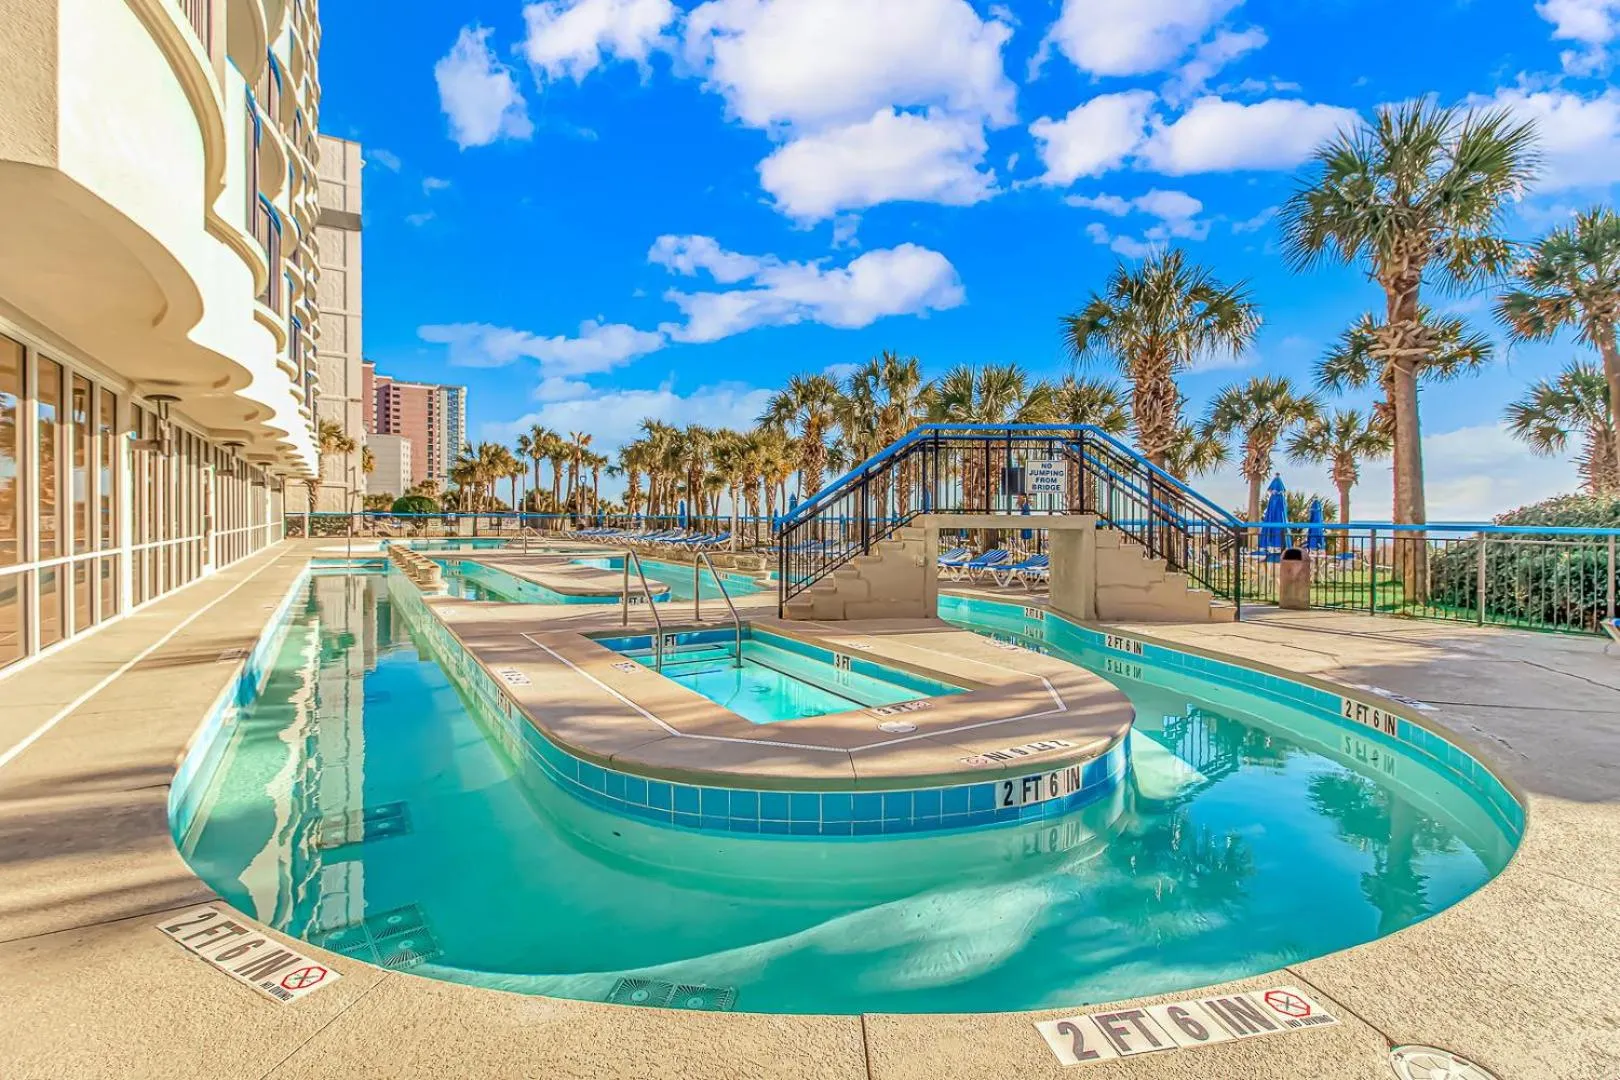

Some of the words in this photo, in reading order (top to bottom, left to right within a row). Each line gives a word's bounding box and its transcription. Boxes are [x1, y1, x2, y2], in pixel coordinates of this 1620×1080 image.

[665, 634, 676, 646] FT
[1108, 635, 1112, 647] 2
[1115, 637, 1123, 650] FT
[1134, 641, 1142, 654] IN
[836, 654, 840, 668] 3
[842, 656, 850, 670] FT
[1346, 700, 1352, 718] 2
[1356, 703, 1369, 724] FT
[1374, 710, 1380, 728] 6
[1384, 714, 1396, 736] IN
[1004, 780, 1013, 806] 2
[1022, 774, 1042, 802] FT
[1050, 773, 1058, 797] 6
[1067, 766, 1080, 793] IN
[164, 912, 218, 933] 2
[182, 920, 250, 950] FT
[215, 939, 266, 962] 6
[233, 950, 303, 982] IN
[1057, 1021, 1100, 1061] 2
[1095, 1010, 1163, 1051] FT
[1167, 1006, 1210, 1041] 6
[1204, 996, 1278, 1036] IN
[1285, 1020, 1302, 1028] NO
[1300, 1014, 1334, 1026] DIVING
